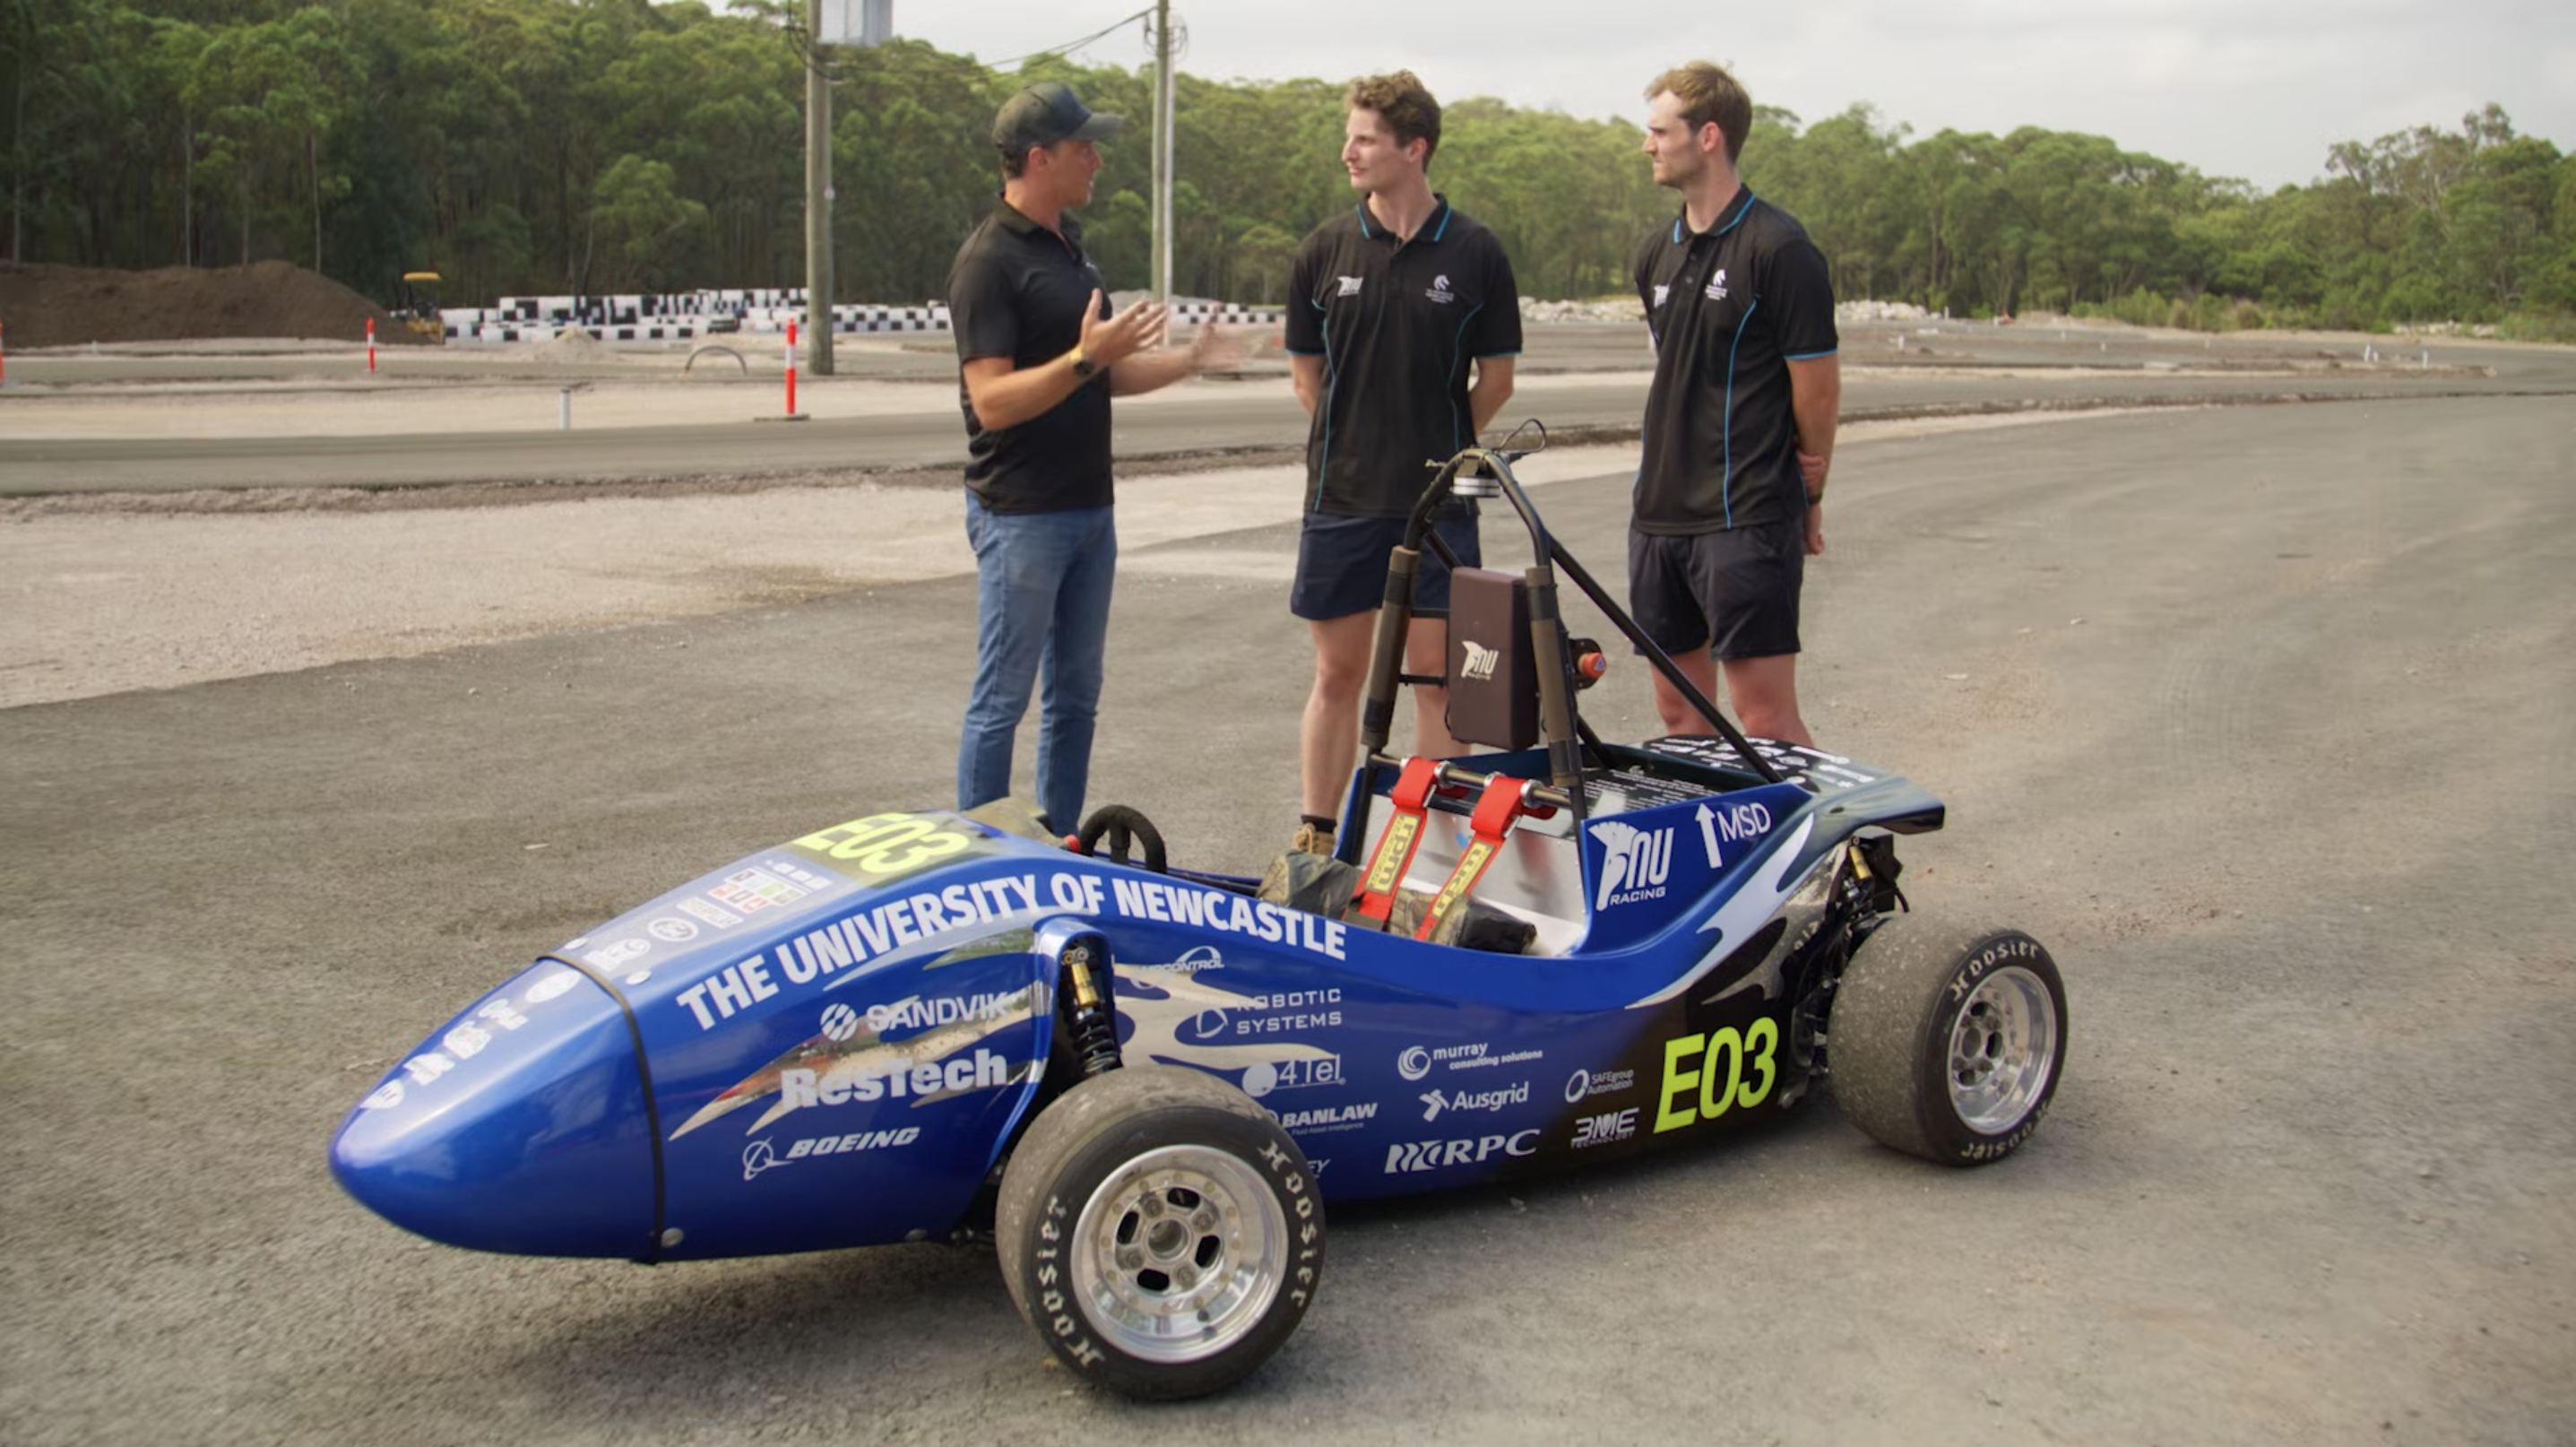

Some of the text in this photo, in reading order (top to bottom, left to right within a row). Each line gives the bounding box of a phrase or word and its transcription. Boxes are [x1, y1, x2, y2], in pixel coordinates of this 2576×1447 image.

[1716, 801, 1771, 843] MSD
[792, 811, 971, 874] E03
[1609, 886, 1666, 906] RACING
[675, 954, 781, 1032] THE
[774, 873, 1039, 984] UNIVERSITY
[1050, 871, 1105, 915] OF
[1111, 877, 1346, 962] NEWCASTLE
[1138, 957, 1225, 975] PCONTROL
[865, 991, 1008, 1033] SANDVIK
[1236, 1010, 1343, 1035] SYSTEMS
[1432, 1042, 1489, 1061] murray
[1448, 1050, 1543, 1070] consulting solutions
[780, 1047, 1008, 1112] ResTech
[1278, 1053, 1342, 1085] 4Tel
[1652, 1016, 1779, 1134] E03
[1450, 1080, 1530, 1112] Ausgrid
[1586, 1079, 1634, 1096] Automation
[1281, 1102, 1379, 1129] BANLAW
[784, 1126, 921, 1159] BOEING
[1441, 1128, 1542, 1165] RPC
[1570, 1131, 1635, 1149] TECHNOLOGY
[1257, 1139, 1318, 1309] Hoosier
[1037, 1194, 1106, 1369] Hoosier
